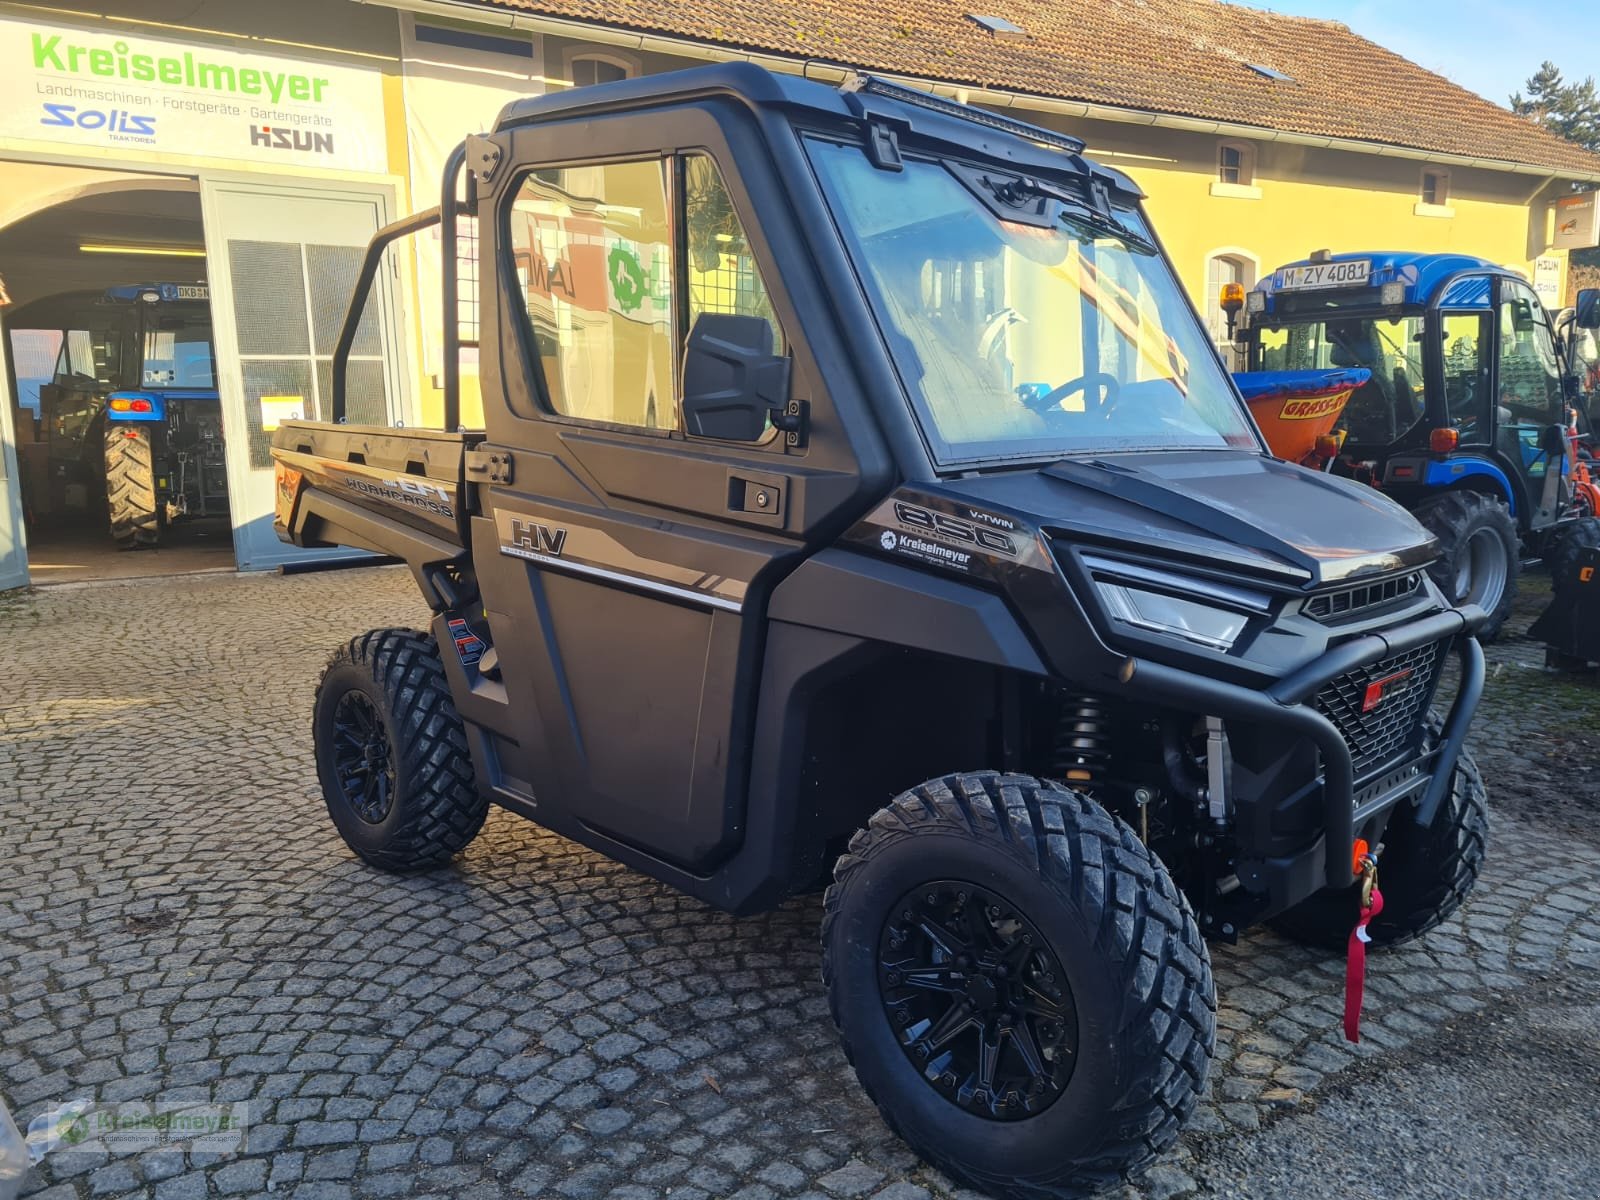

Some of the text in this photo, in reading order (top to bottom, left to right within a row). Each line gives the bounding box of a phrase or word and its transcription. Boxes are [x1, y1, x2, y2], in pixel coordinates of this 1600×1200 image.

[32, 32, 329, 105] Kreiselmeyer
[36, 82, 333, 127] Landmaschinen Forstgeräte Gartengeräte
[108, 134, 157, 145] TRAKTOREN
[1284, 263, 1366, 287] M ZY 4081
[894, 500, 1018, 557] 850
[969, 509, 1014, 530] V-TWIN
[511, 517, 568, 556] HV
[899, 535, 971, 563] Kreiselmeyer
